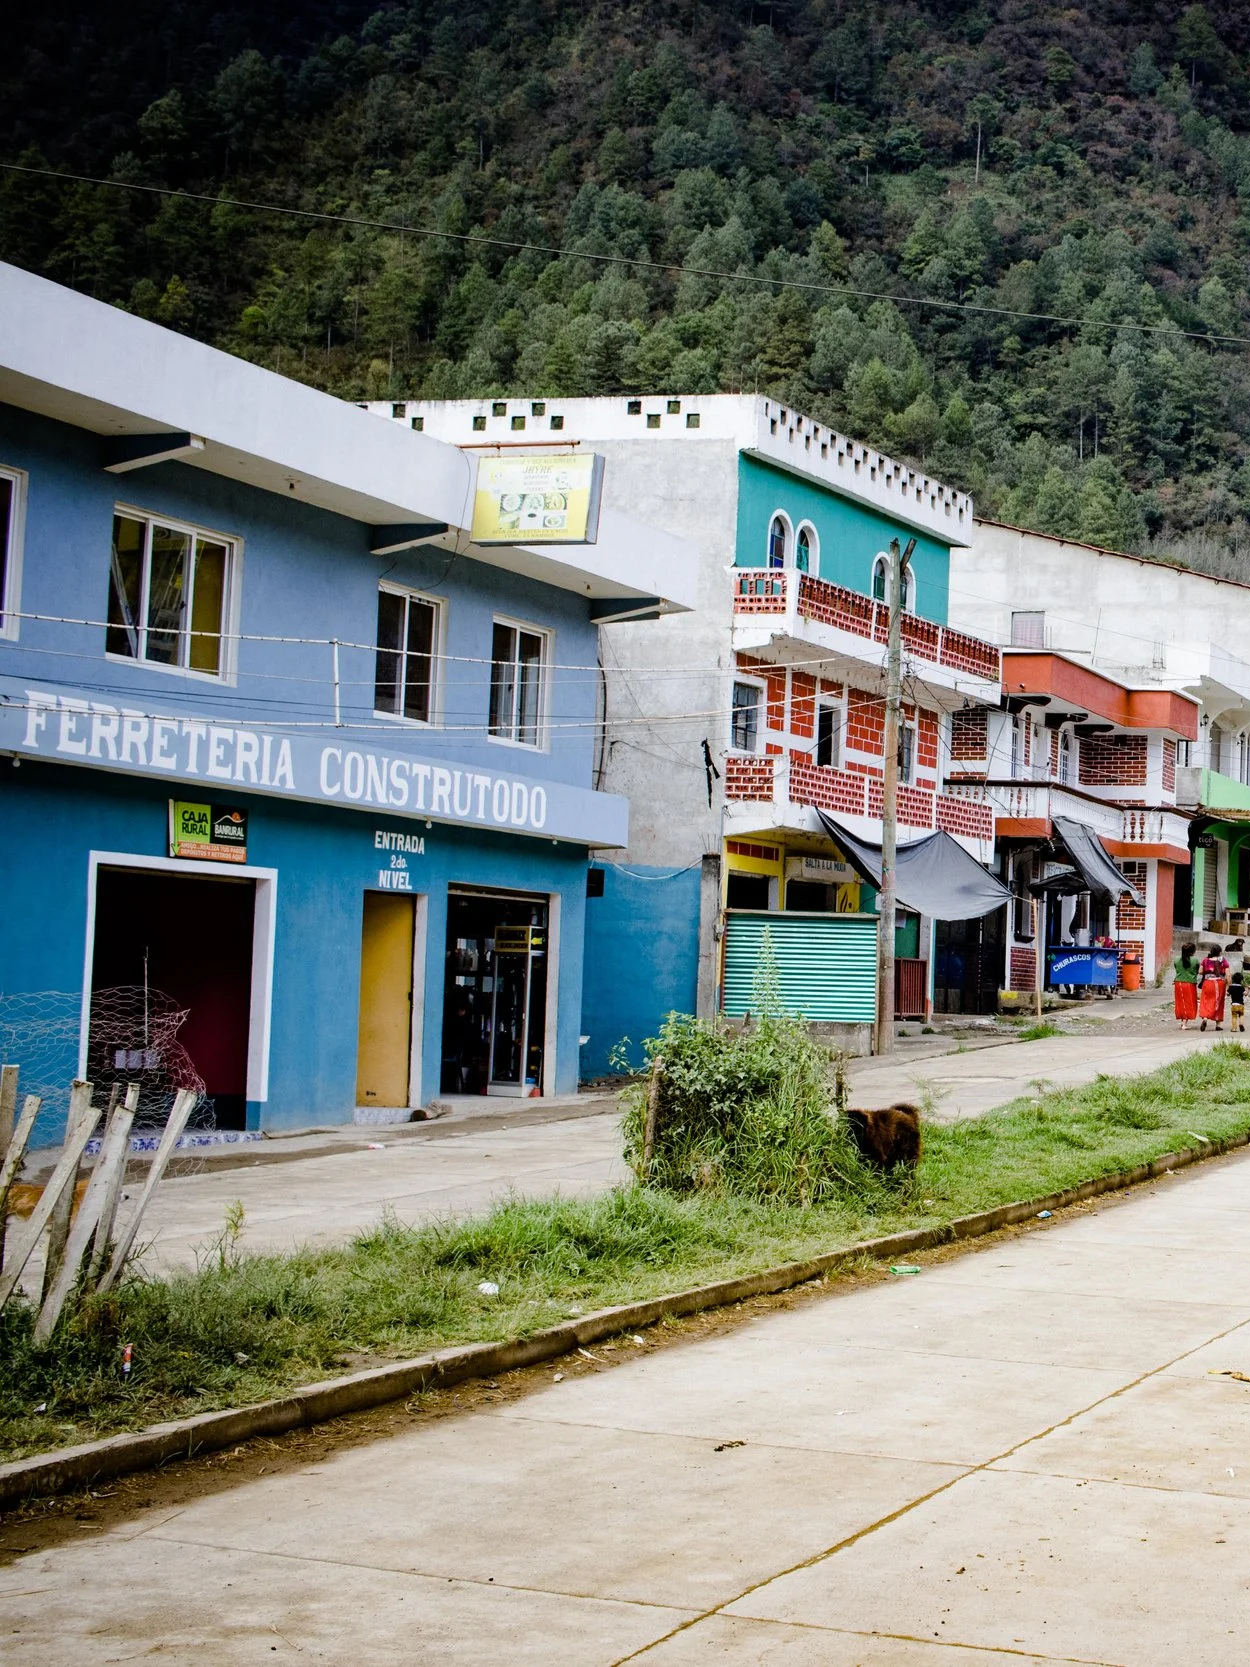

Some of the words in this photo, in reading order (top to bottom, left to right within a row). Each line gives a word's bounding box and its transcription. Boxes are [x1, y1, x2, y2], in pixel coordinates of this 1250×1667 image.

[22, 690, 296, 789] FERRETERIA
[319, 746, 548, 829] CONSTRUTODO
[182, 810, 208, 824] CAJA
[182, 823, 208, 835] RURAL
[214, 824, 244, 837] BANRURAL
[374, 830, 425, 855] ENTRADA
[378, 869, 412, 890] NIVEL
[1052, 954, 1091, 972] CHURASCOS
